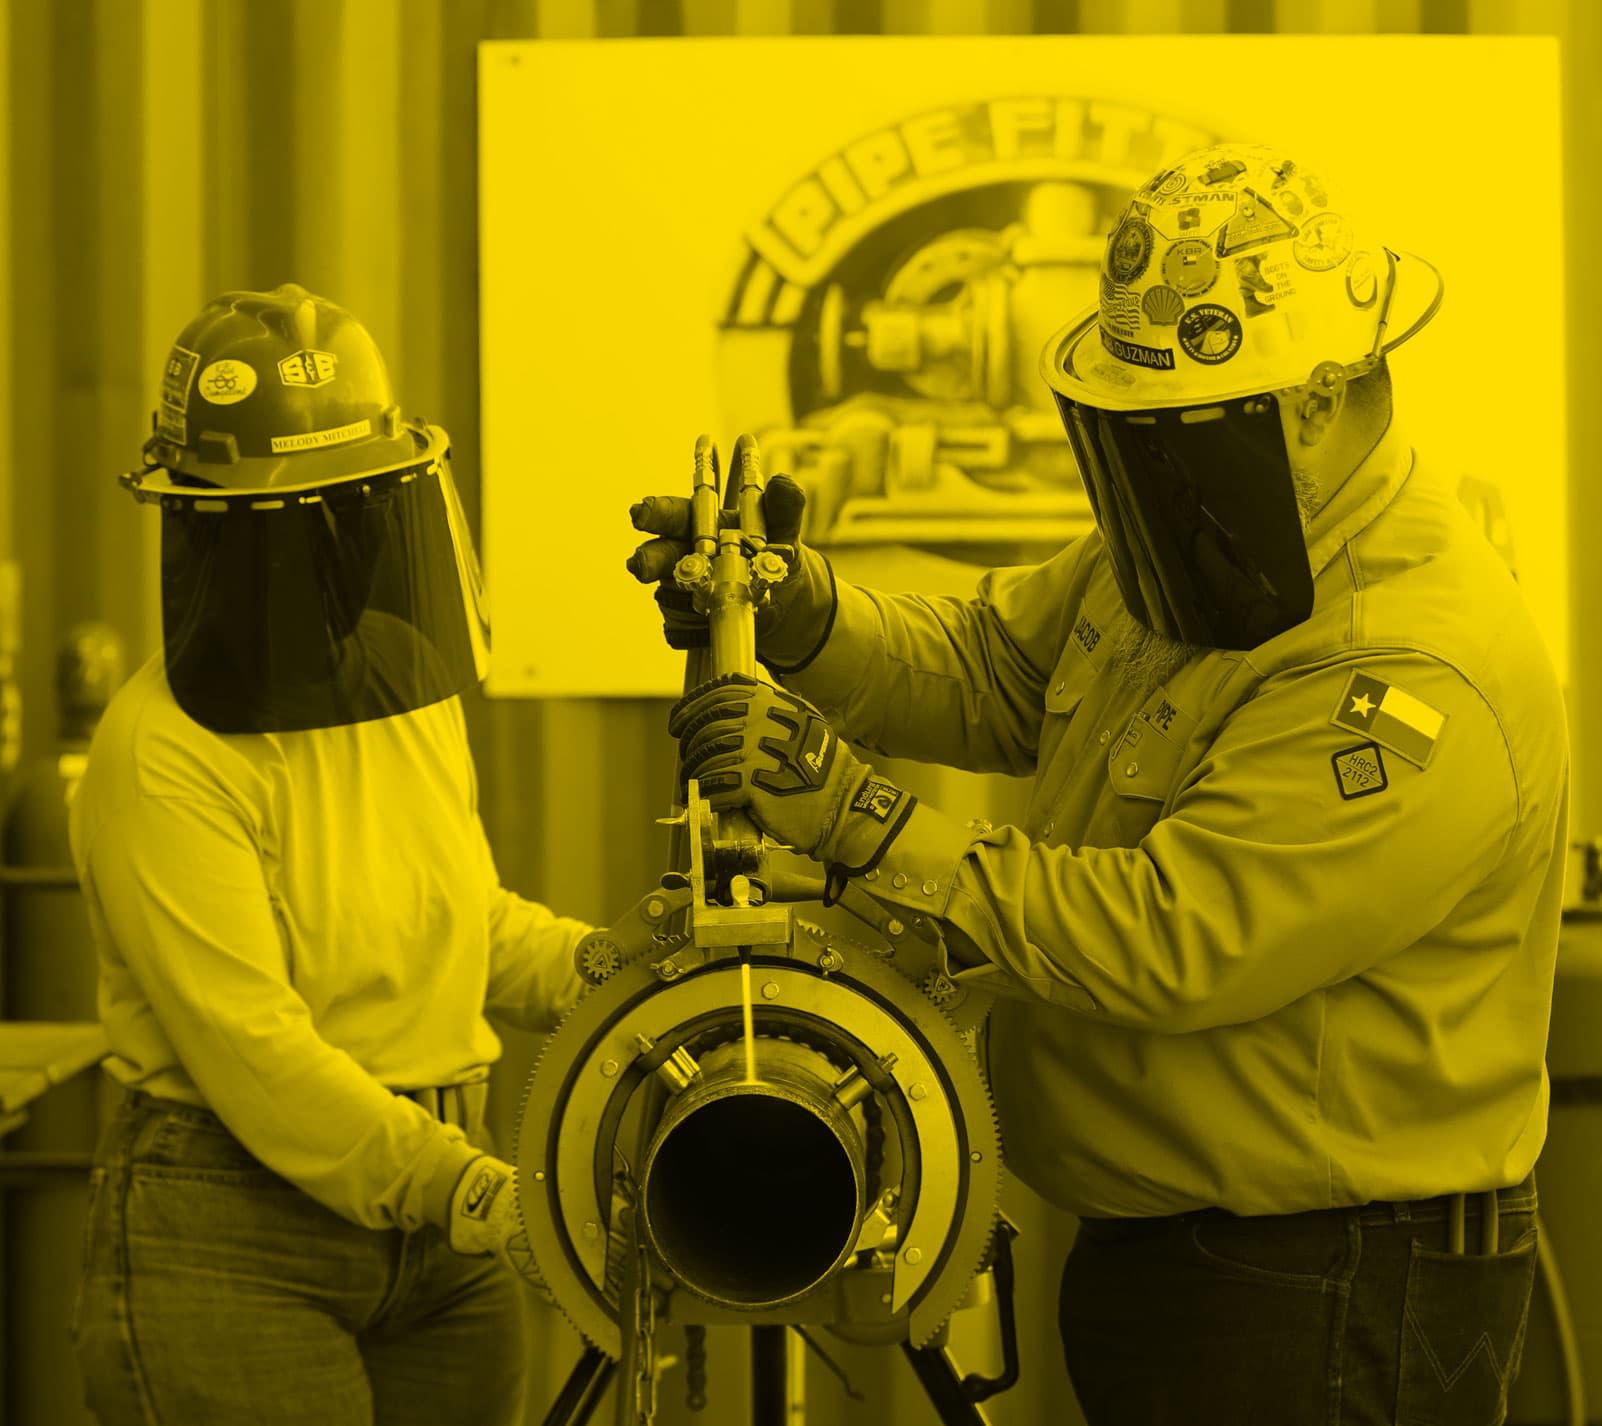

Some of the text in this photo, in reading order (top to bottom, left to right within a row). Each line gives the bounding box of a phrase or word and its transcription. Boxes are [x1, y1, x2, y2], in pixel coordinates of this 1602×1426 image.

[764, 107, 966, 263] PIPE
[1177, 247, 1202, 256] KBR
[1264, 287, 1297, 304] GROUND
[1276, 280, 1291, 290] THE
[1199, 308, 1234, 324] VETERAN
[1114, 342, 1171, 368] GUZMAN
[273, 436, 319, 450] MELODY
[1073, 616, 1101, 653] JACOB
[1153, 698, 1177, 731] PIPE
[1348, 754, 1379, 777] HRC2
[1341, 766, 1371, 788] 2112
